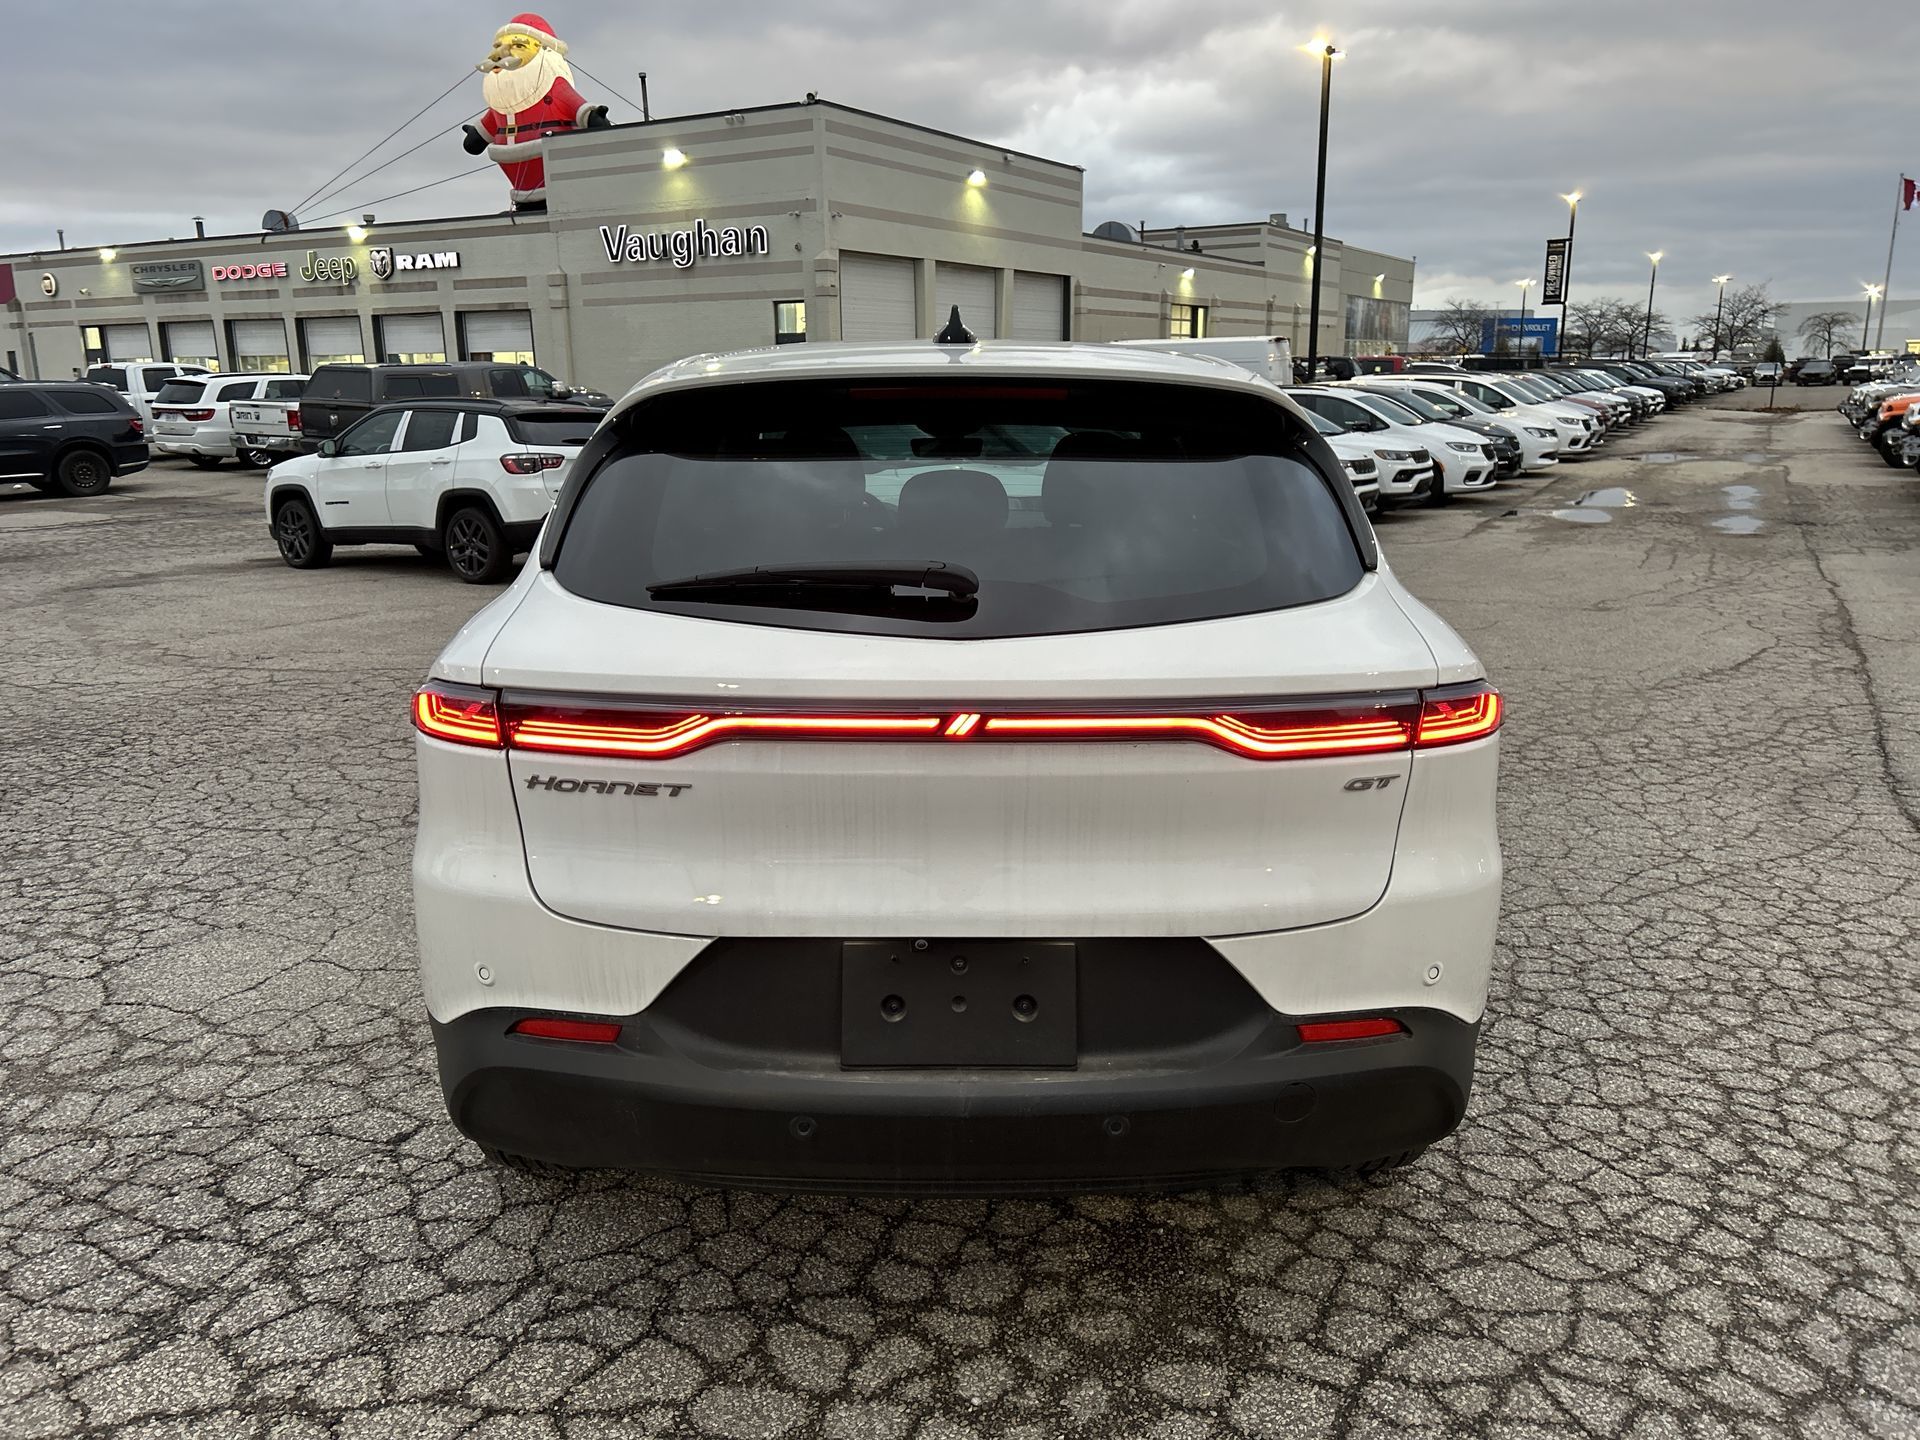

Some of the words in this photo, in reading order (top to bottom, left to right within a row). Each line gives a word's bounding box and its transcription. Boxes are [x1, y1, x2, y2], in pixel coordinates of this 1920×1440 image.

[600, 218, 768, 269] Vaughan
[132, 263, 197, 275] CHRYSLER
[299, 250, 358, 286] Jeep
[395, 251, 459, 271] RAM
[211, 262, 288, 281] DODGE
[1545, 255, 1558, 296] PRE-OWNED
[1511, 323, 1551, 333] CHVROLET
[524, 774, 693, 798] HORNET
[1343, 773, 1401, 791] GT
